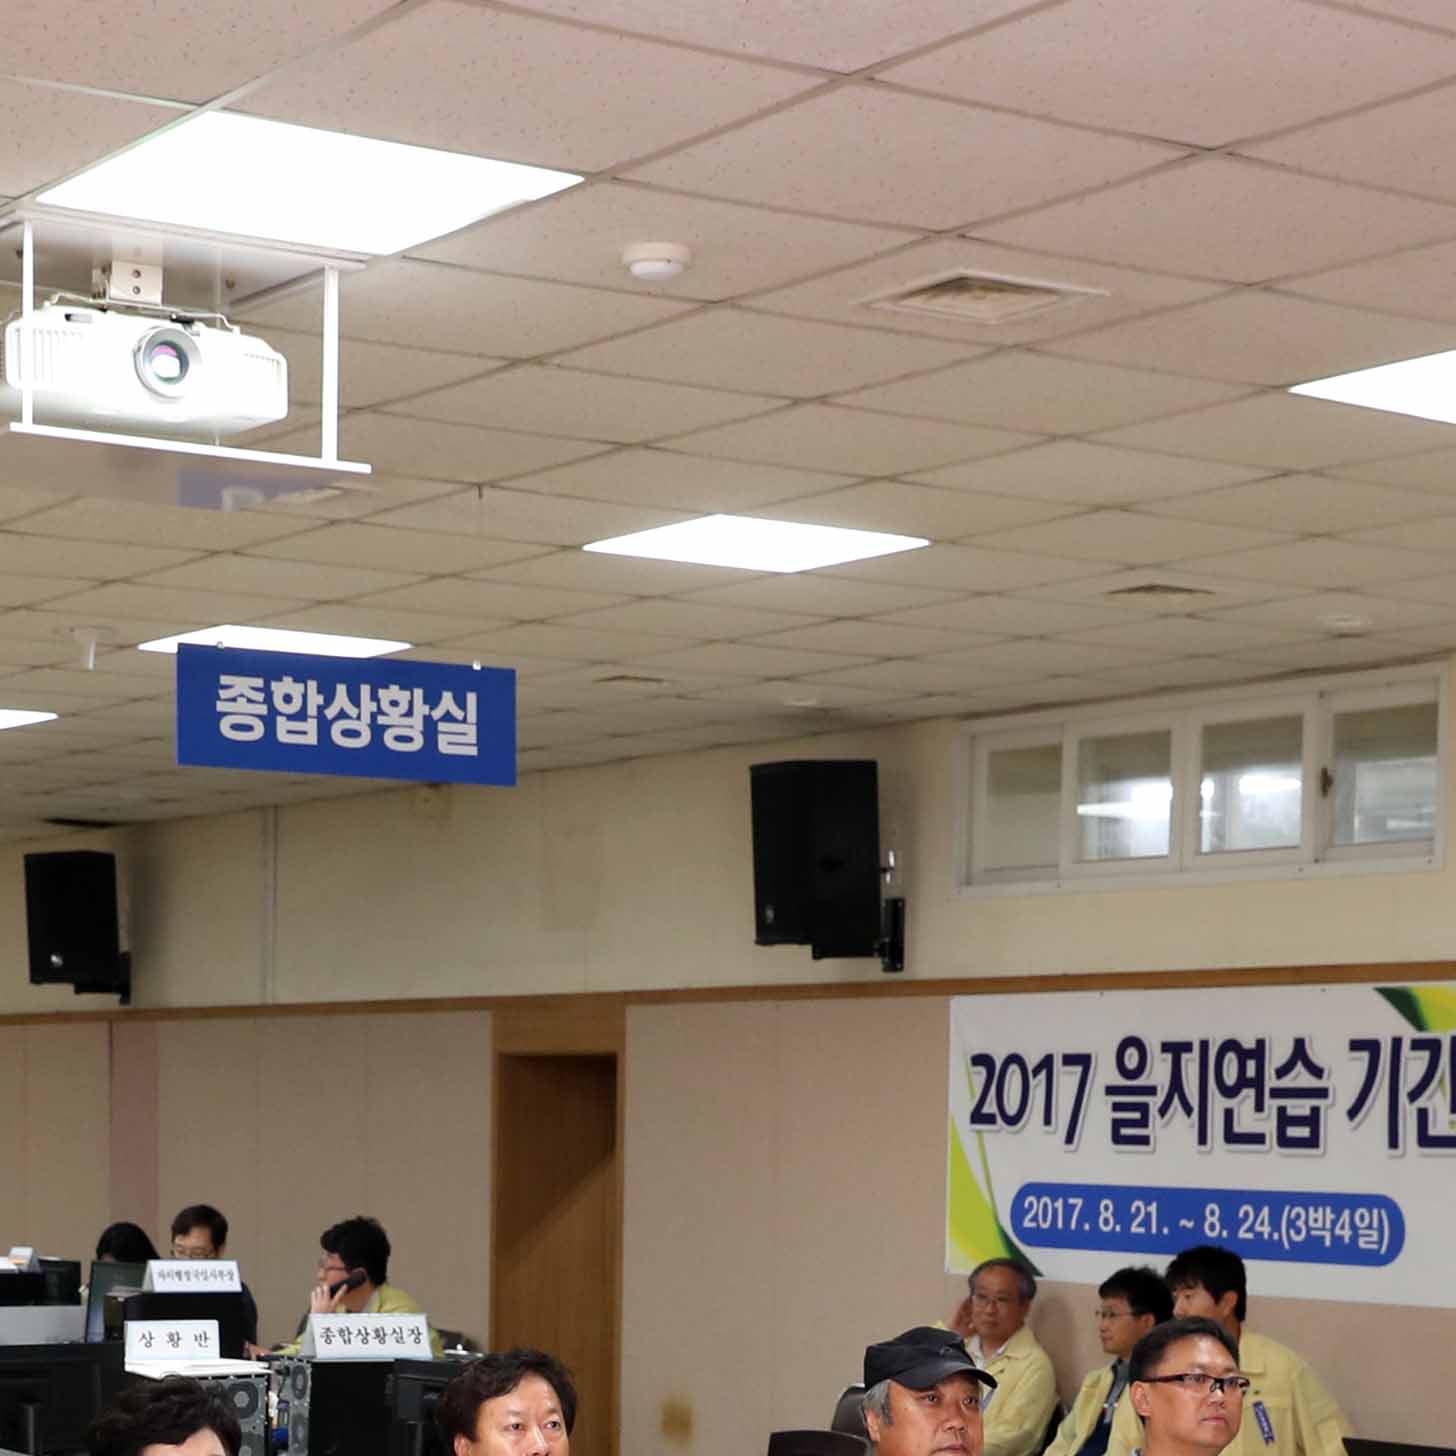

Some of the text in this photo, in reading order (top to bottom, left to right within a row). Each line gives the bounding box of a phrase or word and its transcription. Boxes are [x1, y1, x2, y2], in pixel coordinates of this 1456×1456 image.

[216, 675, 478, 756] 종합상황실
[969, 1053, 1092, 1146] 2017
[1105, 1035, 1329, 1148] 을지연습
[1023, 1196, 1090, 1231] 2017.
[1099, 1200, 1121, 1233] 8.
[1131, 1202, 1169, 1235] 21.
[1204, 1206, 1228, 1238] 8.
[1237, 1204, 1389, 1253] 24.(3박4일)
[138, 1329, 211, 1349] 상황반
[320, 1324, 423, 1345] 종합상황실장
